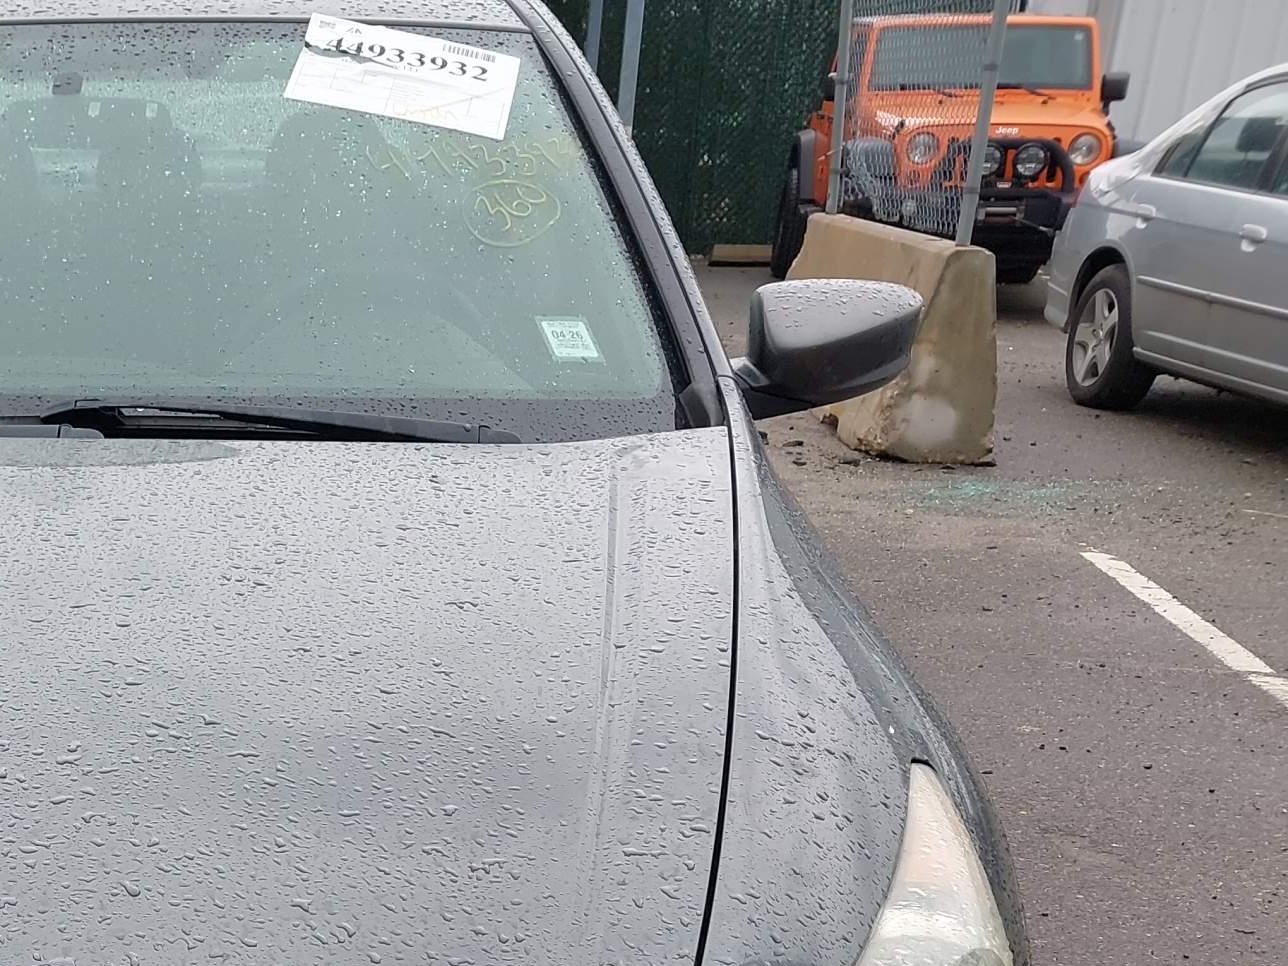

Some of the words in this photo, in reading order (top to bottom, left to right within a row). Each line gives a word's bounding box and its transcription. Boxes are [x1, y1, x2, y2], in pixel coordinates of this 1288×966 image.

[326, 36, 488, 82] 44933932
[995, 126, 1019, 135] Jeep
[474, 187, 546, 231] 360
